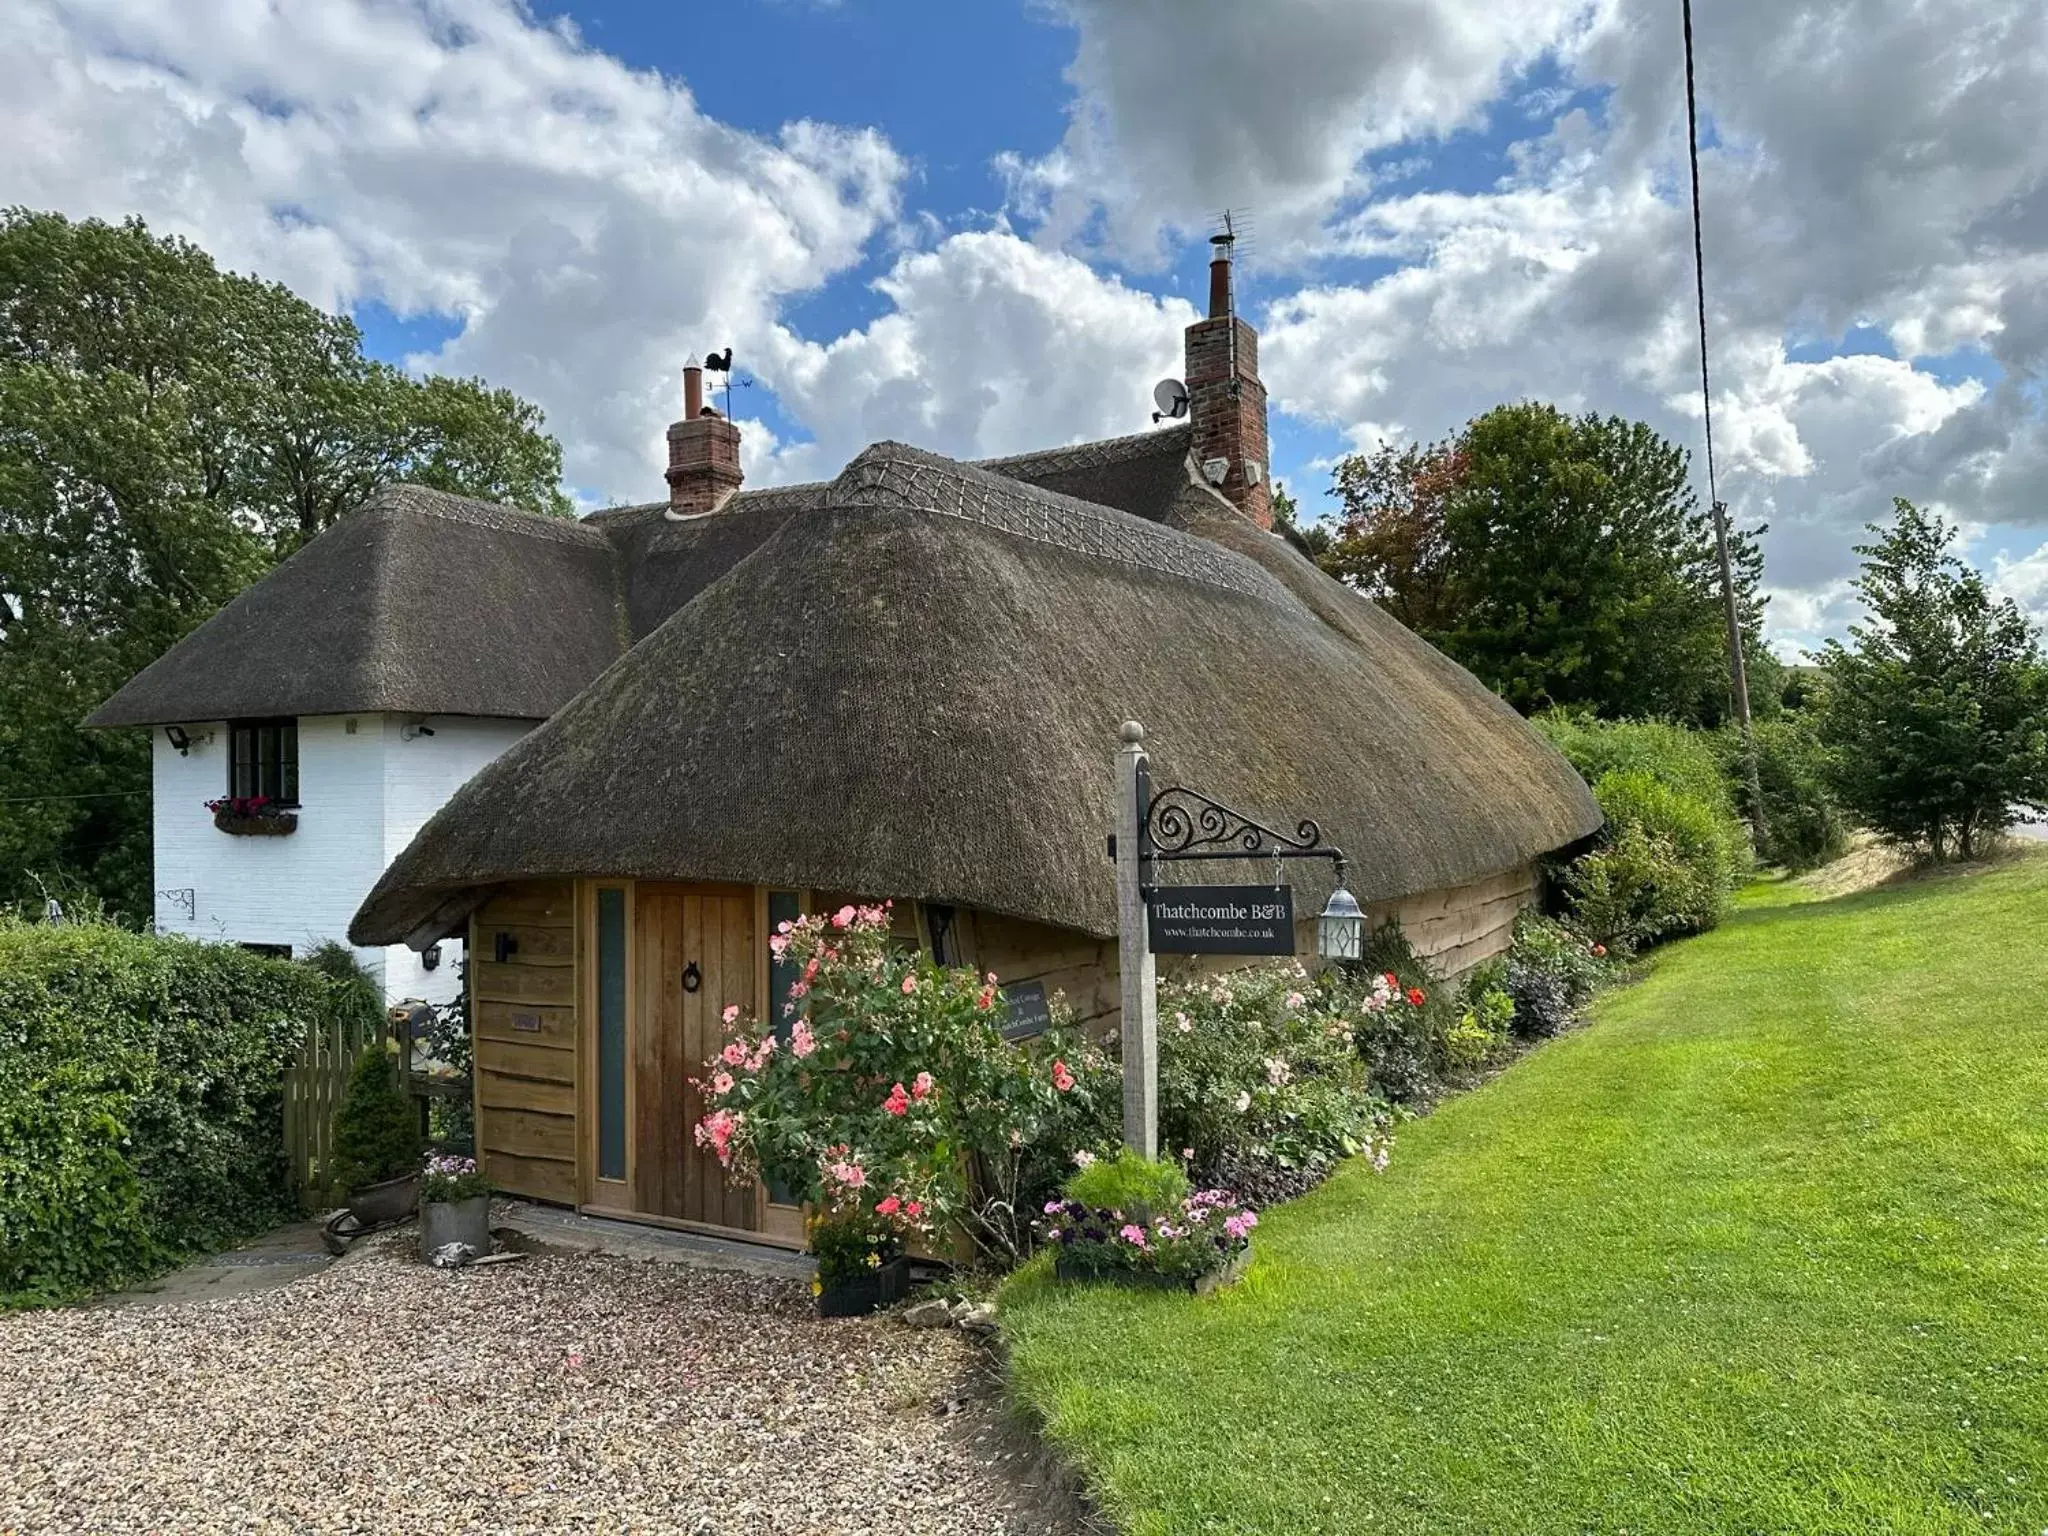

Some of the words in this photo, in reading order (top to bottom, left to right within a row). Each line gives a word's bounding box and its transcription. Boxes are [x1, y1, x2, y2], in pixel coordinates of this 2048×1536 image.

[1154, 903, 1247, 919] Thatchcombe
[1252, 904, 1286, 920] B&B
[1164, 926, 1275, 938] www.thatchcombe.co.uk
